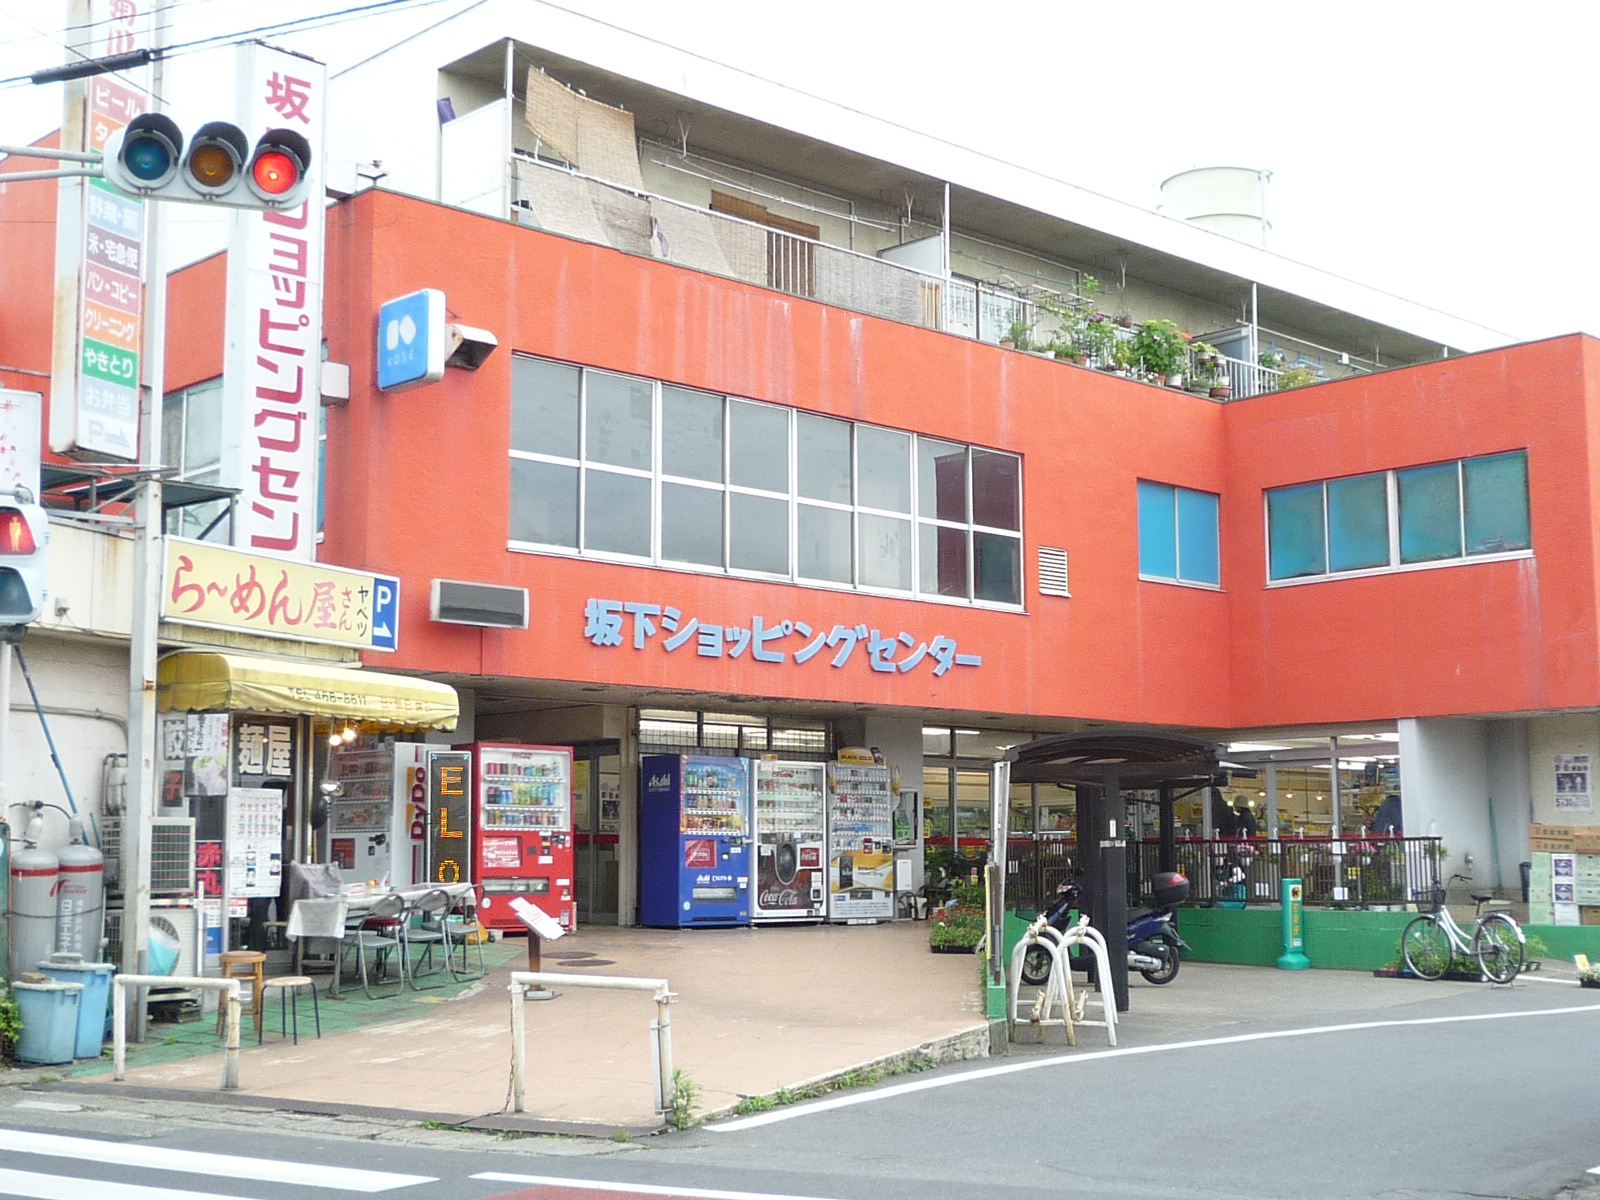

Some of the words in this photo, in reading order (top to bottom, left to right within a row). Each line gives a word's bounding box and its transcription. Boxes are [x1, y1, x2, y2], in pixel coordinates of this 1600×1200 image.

[96, 84, 141, 117] ビール
[88, 231, 138, 270] 米・宅急便
[86, 271, 138, 304] パン・コピー
[85, 307, 136, 342] クリーニング
[84, 347, 134, 379] やきとり
[85, 386, 131, 416] お弁当
[88, 419, 104, 443] P
[376, 585, 392, 613] P
[584, 597, 982, 678] 坂下ショッピングセンター
[288, 687, 312, 701] TEL
[648, 773, 671, 788] Asahi
